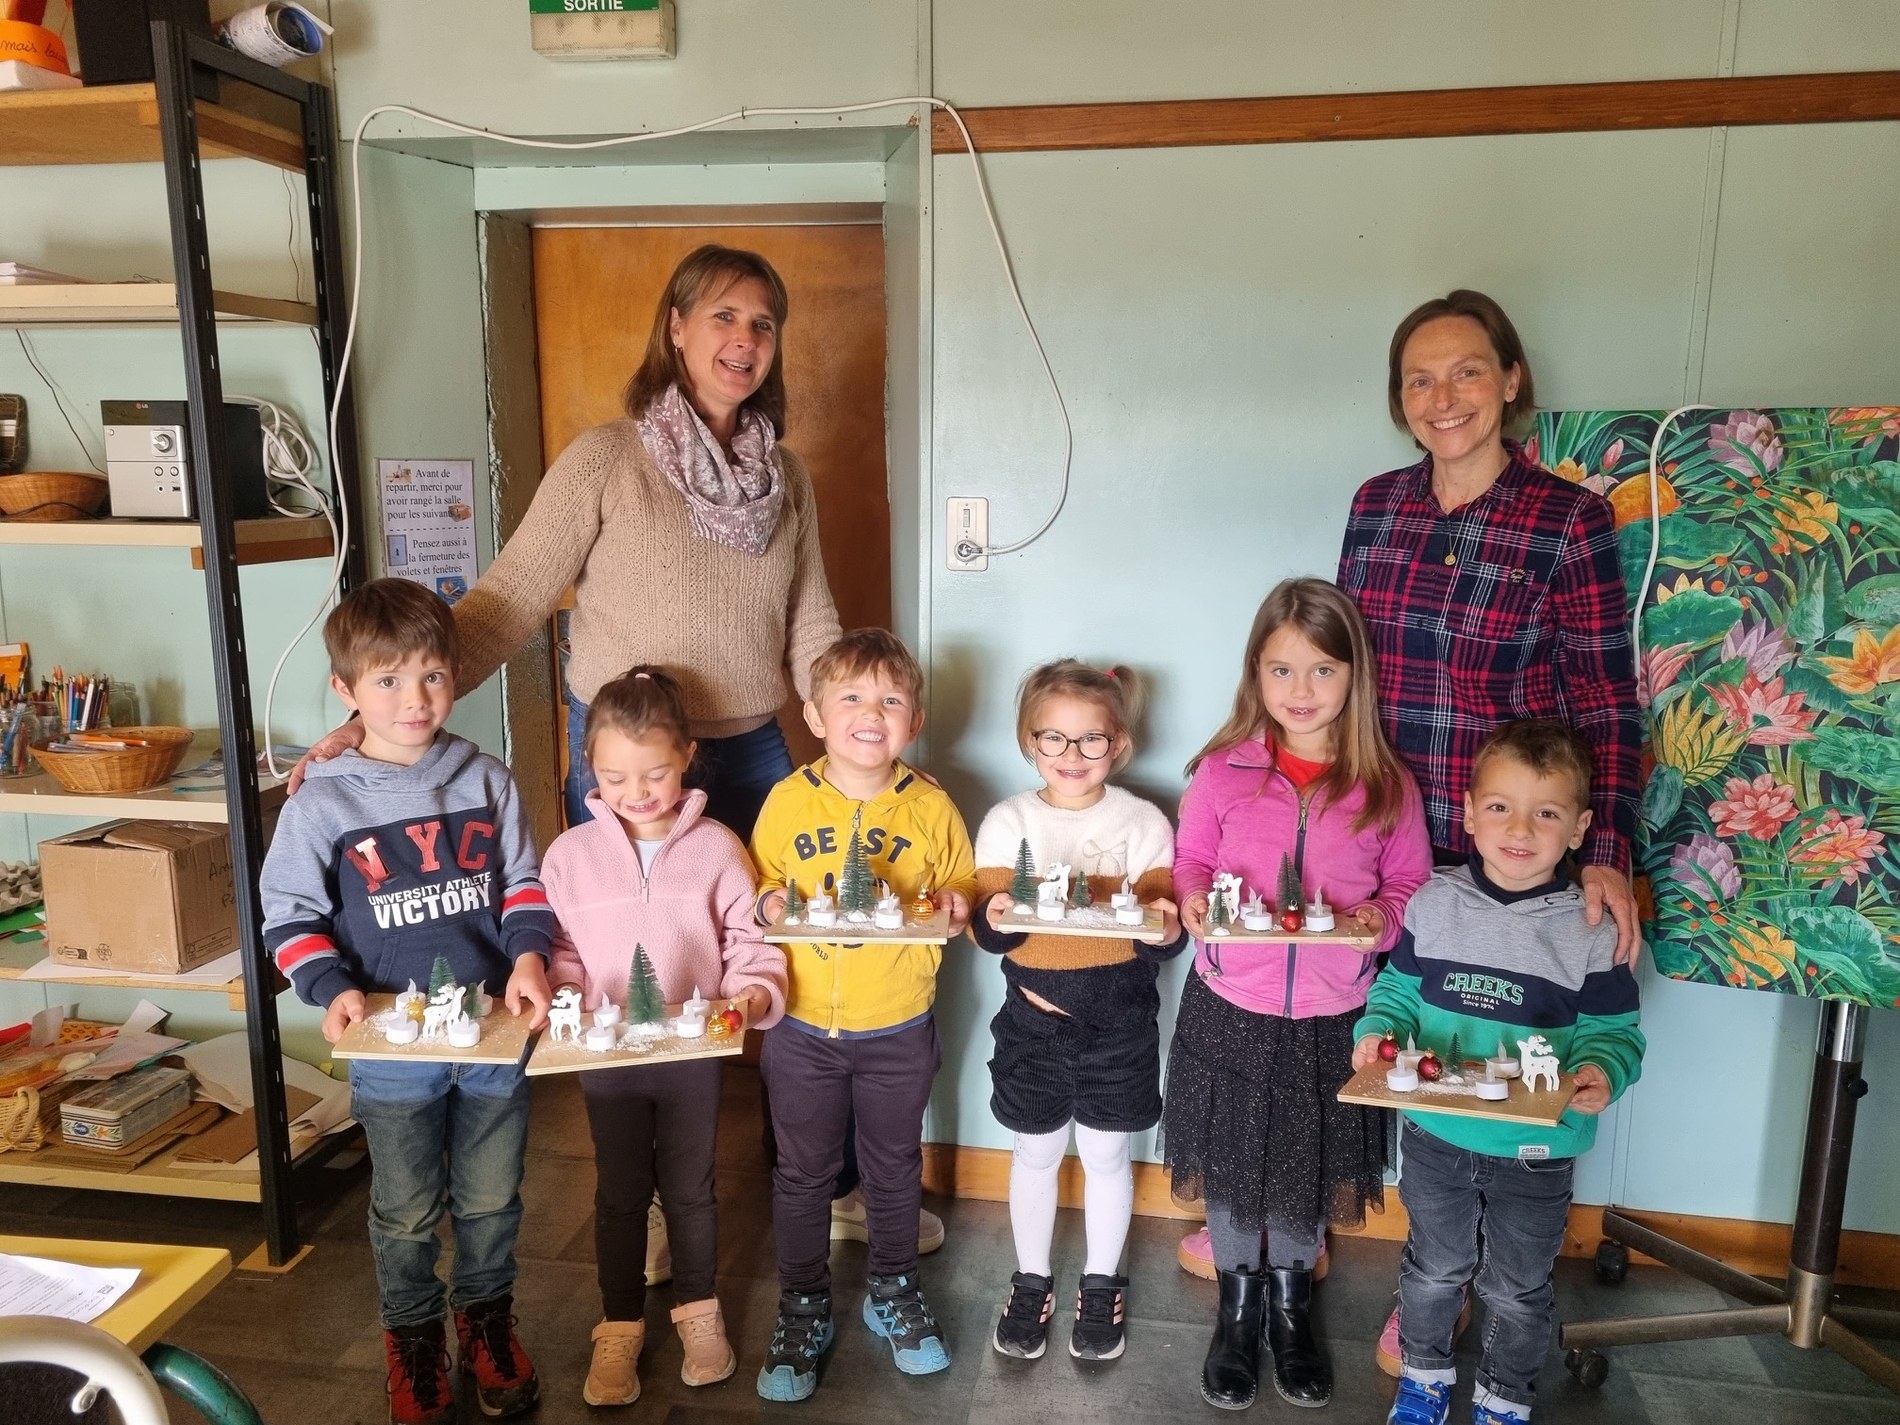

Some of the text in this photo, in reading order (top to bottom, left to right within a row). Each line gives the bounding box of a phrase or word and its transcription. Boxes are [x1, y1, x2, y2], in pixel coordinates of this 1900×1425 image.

[564, 0, 623, 11] SORTIE
[415, 469, 451, 478] Avant de
[386, 482, 463, 494] repartir, merci pour
[386, 495, 461, 508] avoir rangé la salle
[387, 511, 407, 521] pour
[409, 510, 420, 519] les
[413, 537, 467, 549] Pensez aussi à
[409, 550, 470, 563] la fermeture des
[397, 564, 462, 577] volets et fenêtres
[367, 871, 492, 906] UNIVERSITY ATHLETE
[373, 882, 491, 929] VICTORY
[810, 943, 829, 961] ORLD
[1443, 972, 1525, 1006] CREEKS
[1460, 993, 1500, 1006] ORIGINAL
[1462, 1000, 1495, 1010] Since 1974
